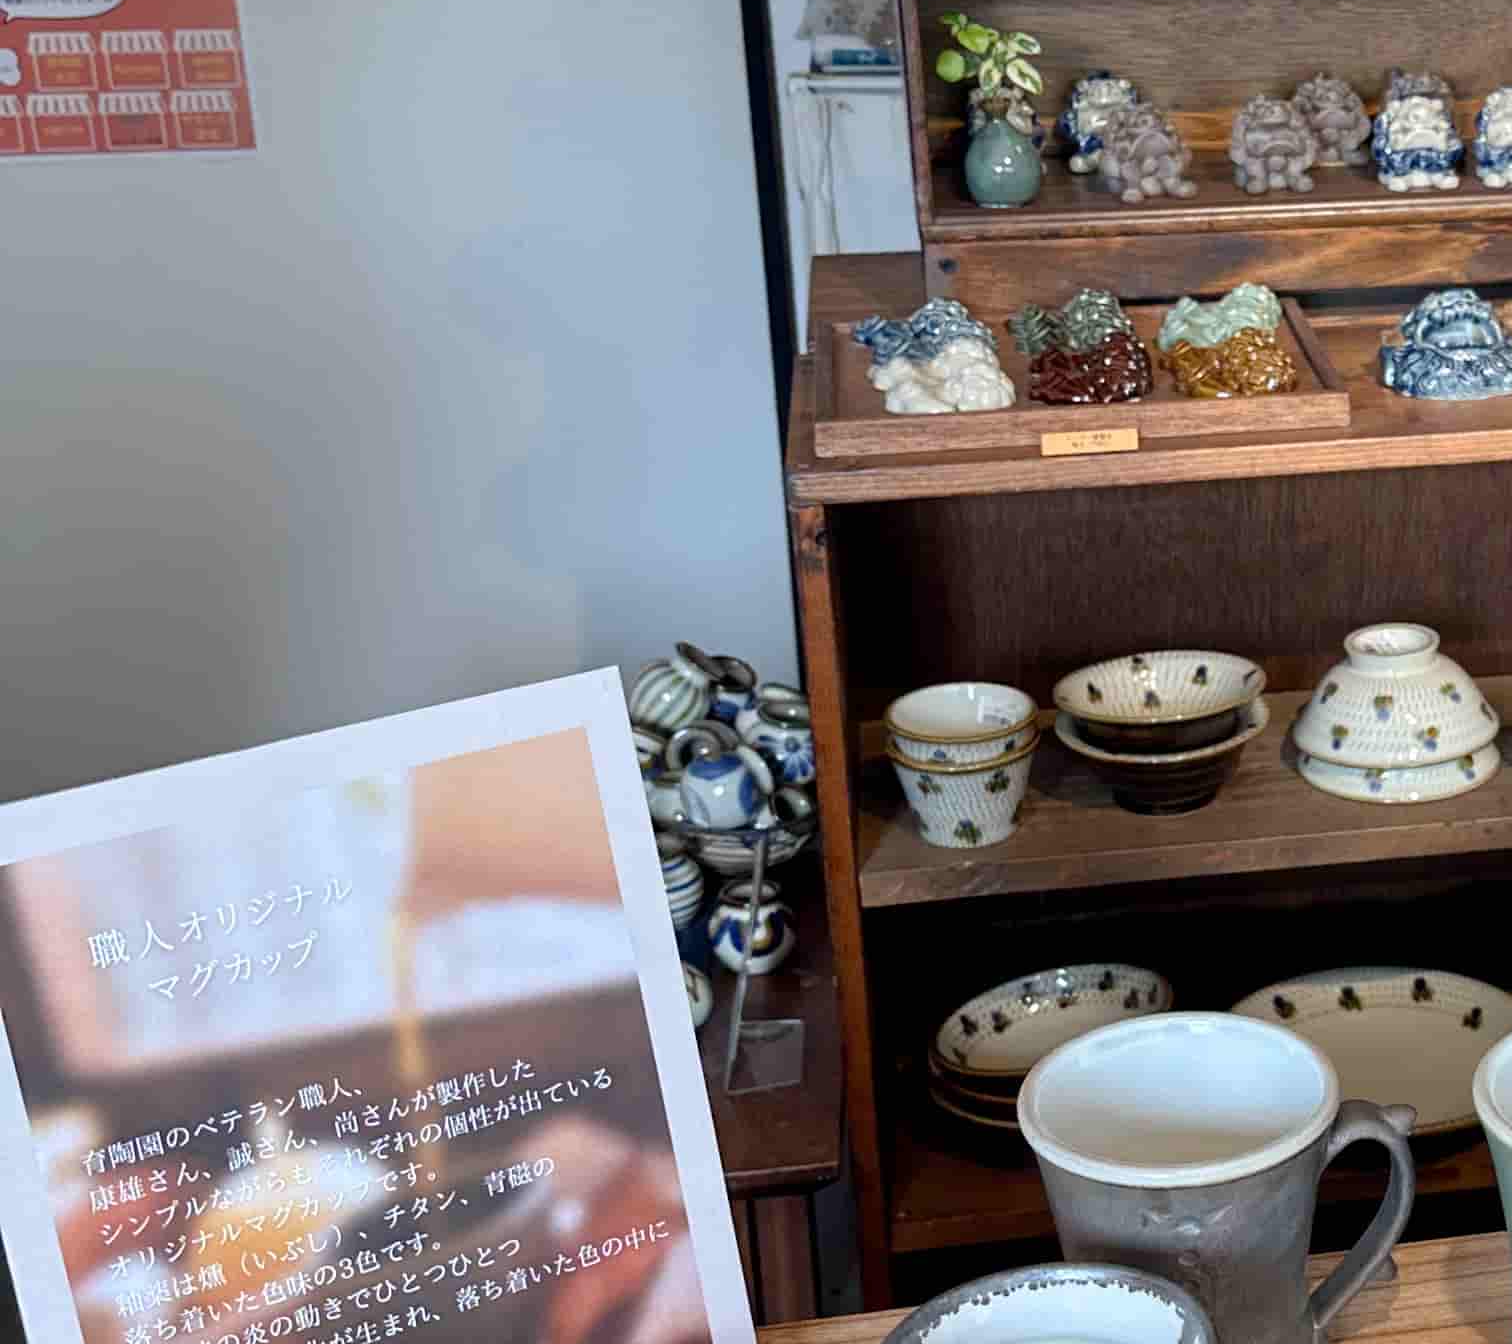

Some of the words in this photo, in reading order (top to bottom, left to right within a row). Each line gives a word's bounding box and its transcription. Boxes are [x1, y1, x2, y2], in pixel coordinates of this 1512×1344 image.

[87, 878, 352, 969] 職人オリジナル
[148, 930, 318, 999] マグカップ
[110, 1161, 438, 1280] オリジナルマグカップです。
